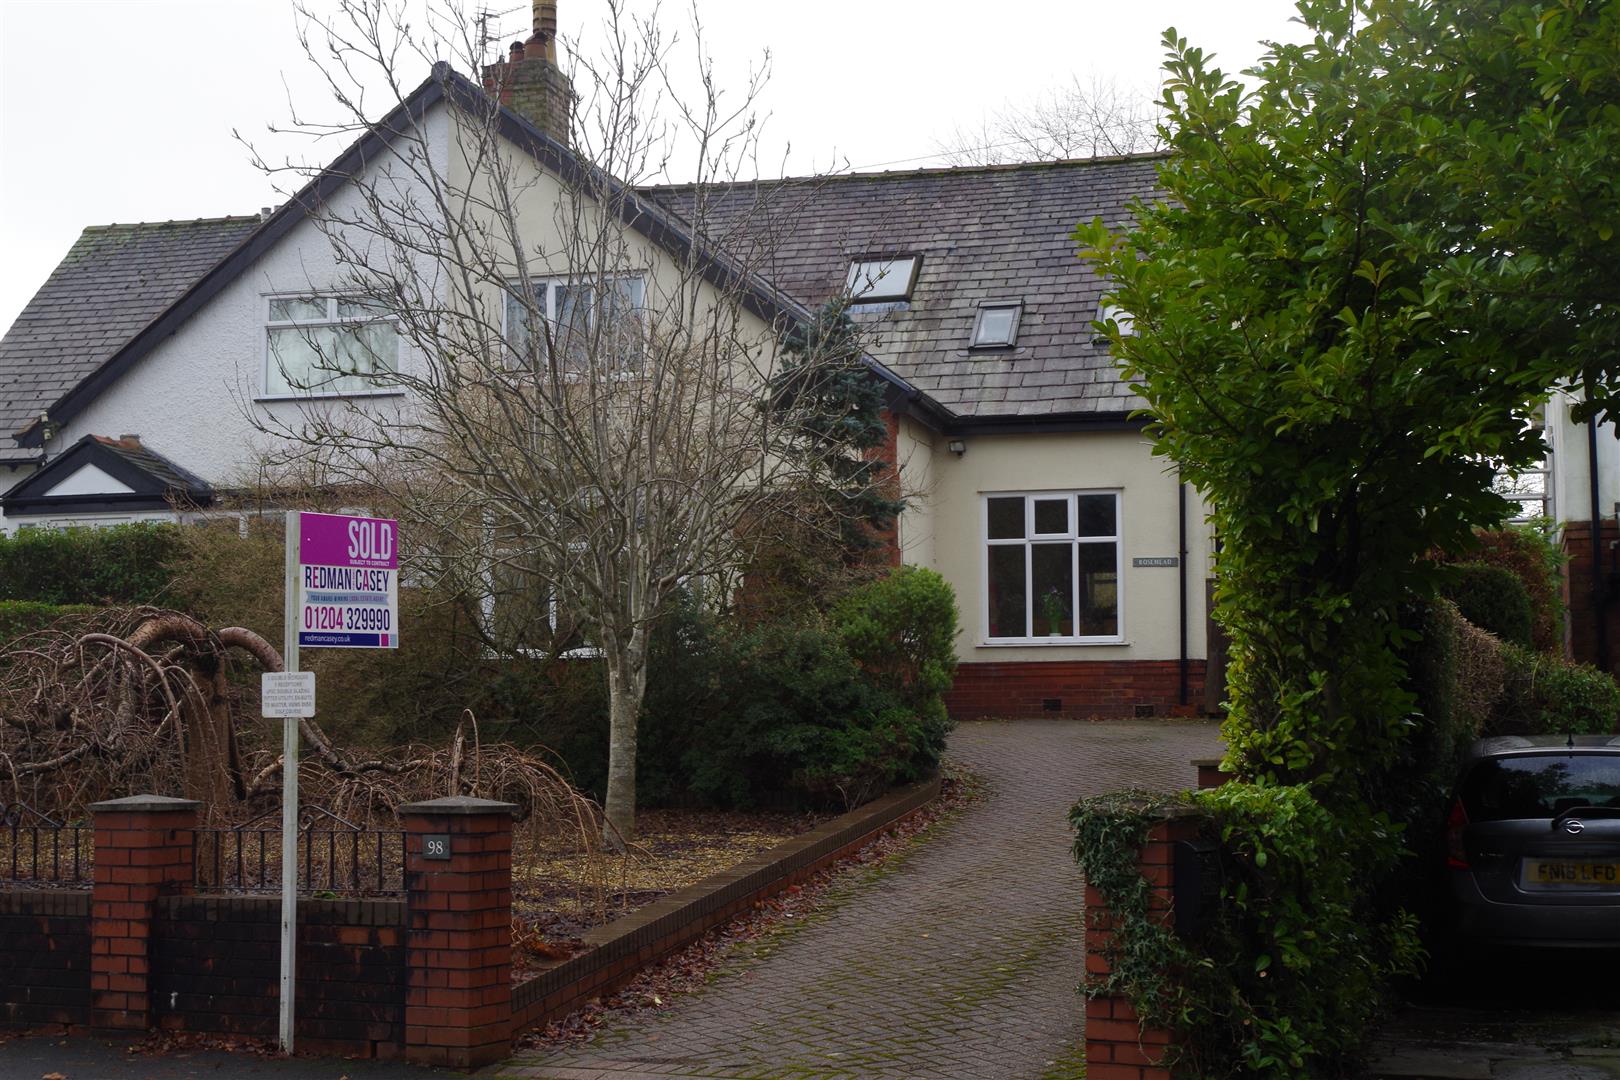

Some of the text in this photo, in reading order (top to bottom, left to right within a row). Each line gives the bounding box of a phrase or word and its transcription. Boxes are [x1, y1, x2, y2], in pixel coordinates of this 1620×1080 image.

[348, 520, 392, 560] SOLD
[305, 566, 352, 590] REDMAN
[355, 569, 389, 592] CASEY
[305, 606, 390, 631] 01204 329990
[304, 634, 351, 644] redmancasey.co.uk
[428, 841, 443, 855] 98
